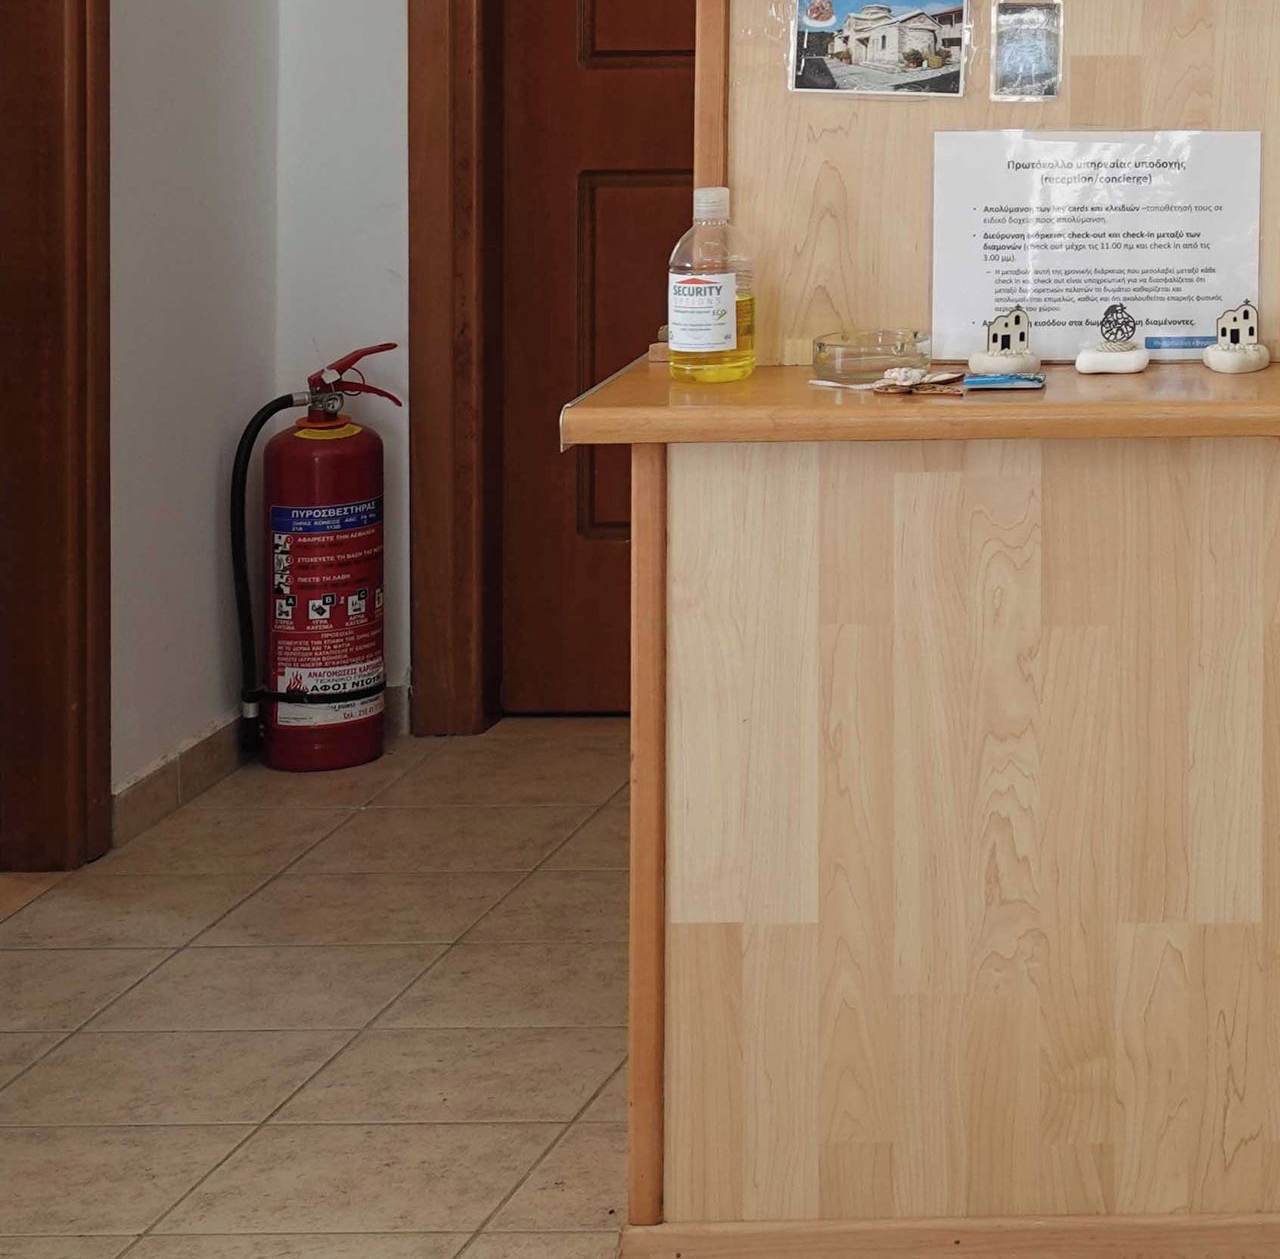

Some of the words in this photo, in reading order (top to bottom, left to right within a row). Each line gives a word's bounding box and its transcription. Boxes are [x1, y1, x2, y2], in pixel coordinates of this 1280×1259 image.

[1007, 160, 1073, 170] Πρωτόκολλο
[1134, 160, 1186, 170] υποδοχής
[1041, 174, 1152, 185] (reception/concierge)
[1068, 231, 1106, 239] check-out
[1156, 231, 1184, 240] μεταξύ
[673, 286, 722, 296] SECURITY
[1034, 319, 1066, 327] εισόδου
[1145, 319, 1195, 327] διαμένοντες.
[292, 502, 375, 518] ΠΥΡΟΣΒΕΣΤΗΡΑΣ
[307, 668, 357, 678] ΑΝΑΓΟΜΩΣΕΙΣ
[311, 683, 347, 691] ΑΦΟΙ
